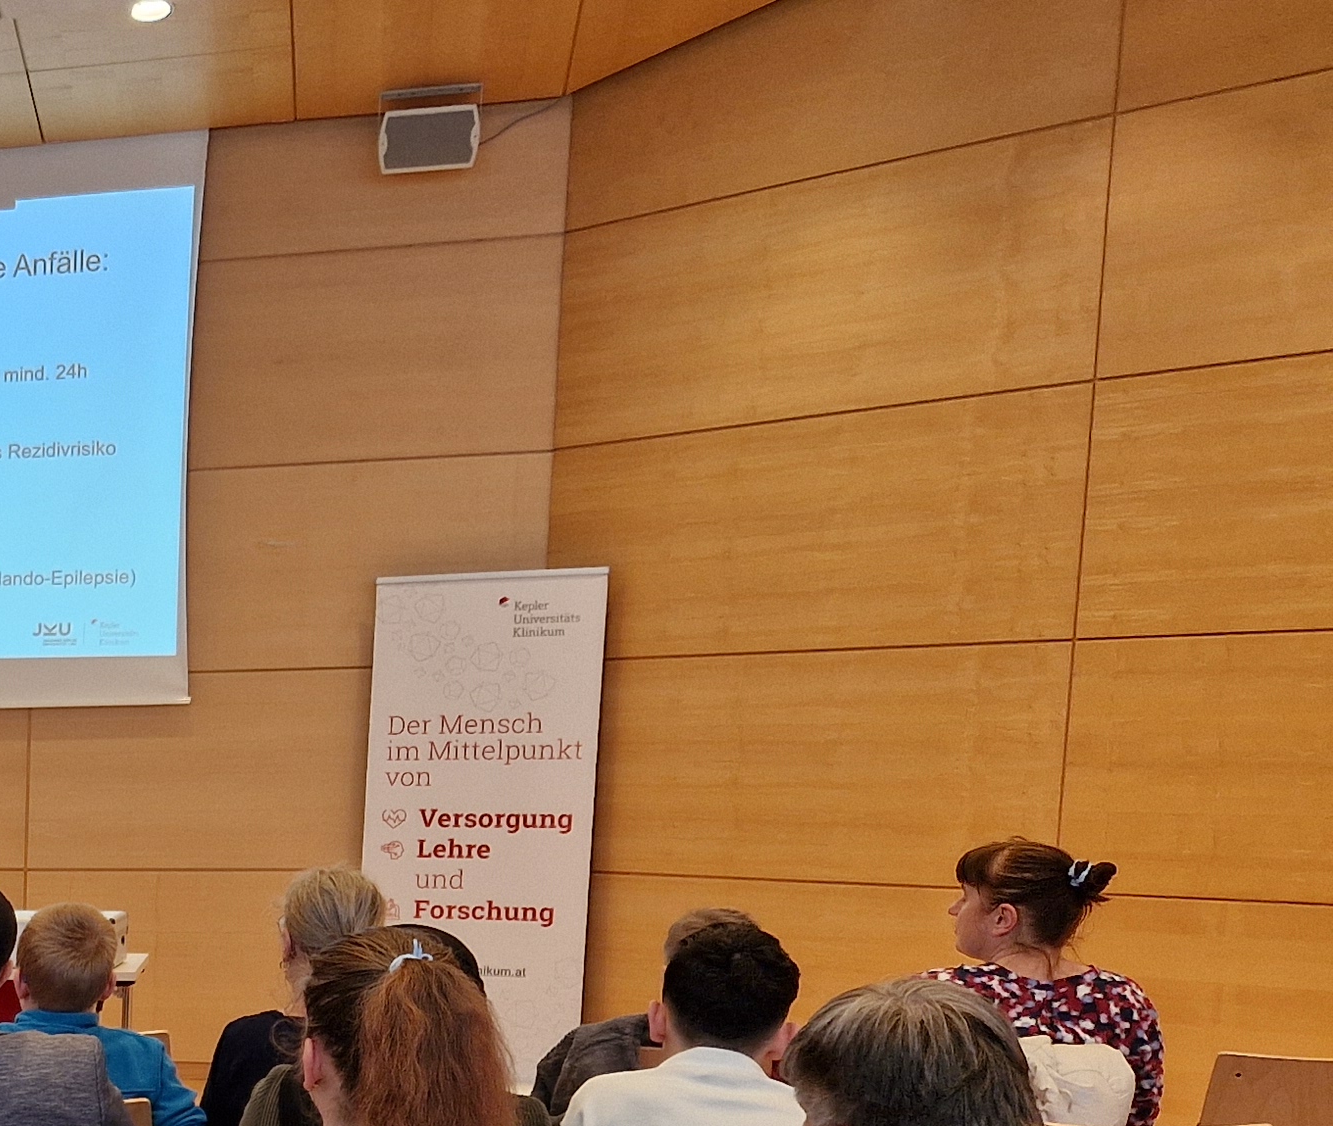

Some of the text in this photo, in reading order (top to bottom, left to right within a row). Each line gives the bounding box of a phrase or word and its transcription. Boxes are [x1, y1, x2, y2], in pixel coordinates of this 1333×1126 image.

[13, 248, 109, 278] Anfälle:
[4, 365, 50, 383] mind.
[55, 363, 88, 381] 24h
[8, 440, 117, 460] Rezidivrisiko
[514, 600, 549, 613] Kepler
[513, 612, 581, 625] Universitäts
[512, 626, 565, 638] Klinikum
[387, 712, 543, 736] Der Mensch
[386, 738, 583, 766] im Mittelpunkt
[386, 770, 431, 787] von
[419, 808, 573, 834] Versorgung
[416, 838, 491, 859] Lehre
[415, 869, 464, 890] und
[413, 899, 555, 927] Forschung
[478, 966, 526, 977] nikum.at
